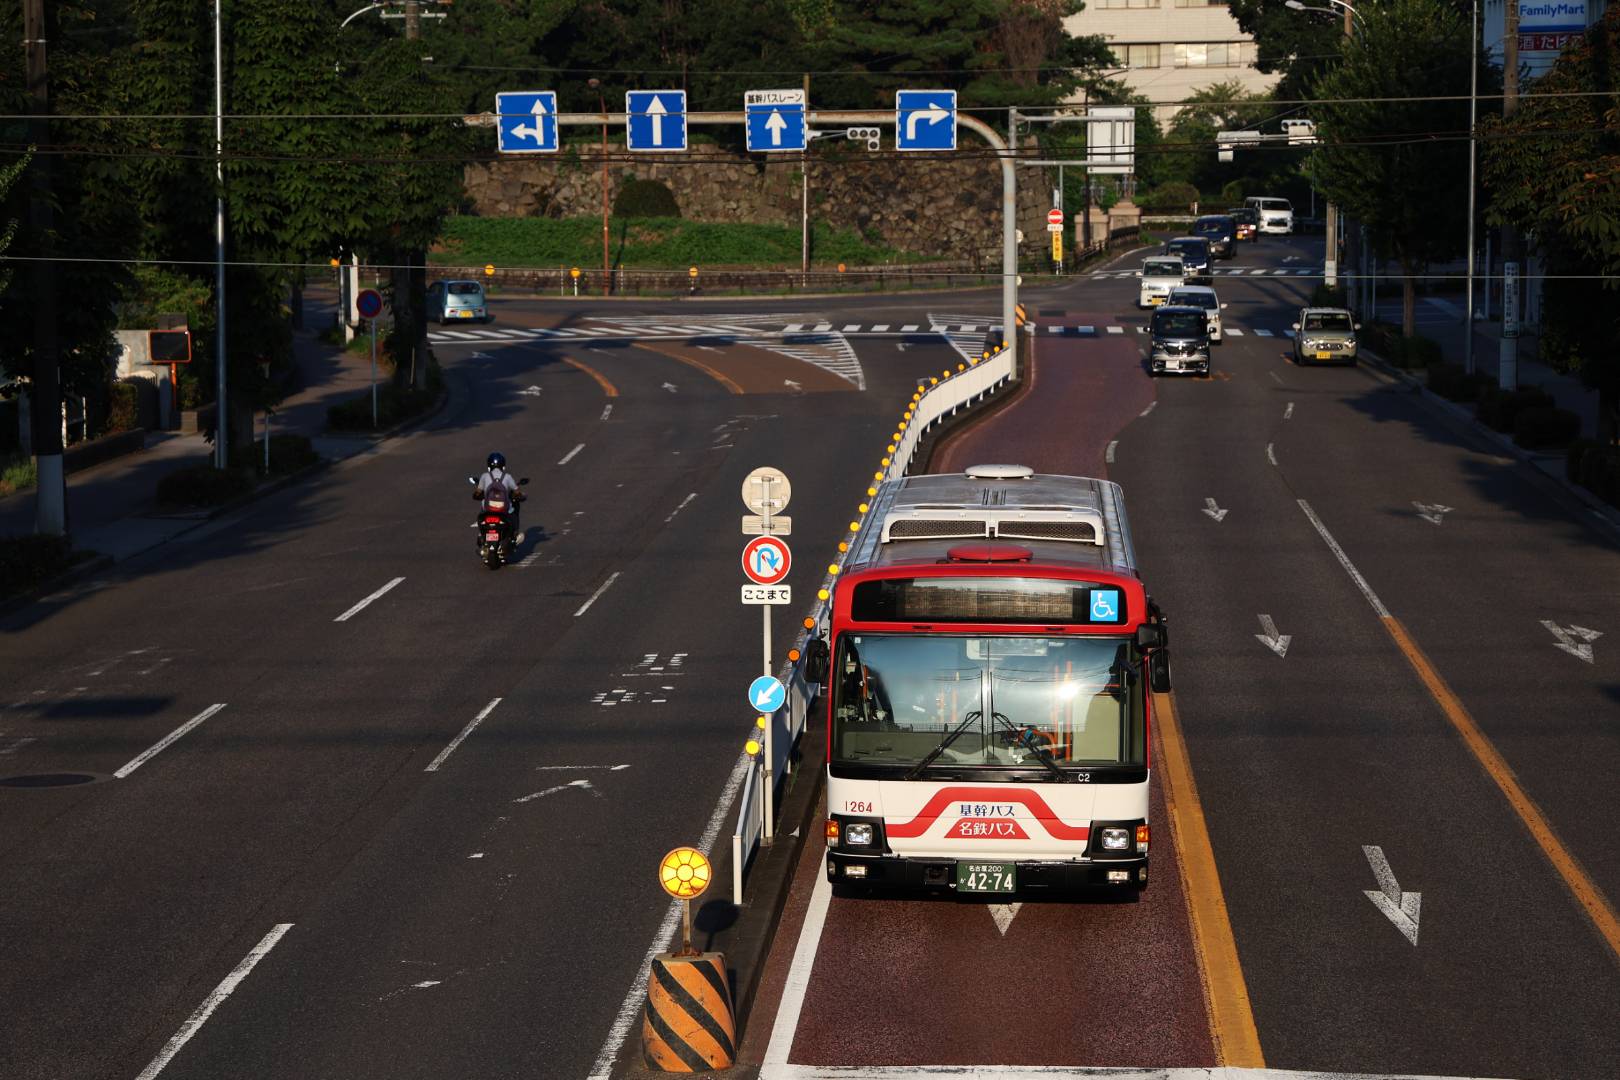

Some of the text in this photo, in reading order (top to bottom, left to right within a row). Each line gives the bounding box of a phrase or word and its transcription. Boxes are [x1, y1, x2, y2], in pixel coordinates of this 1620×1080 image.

[1520, 4, 1584, 17] FamilyMart
[748, 93, 802, 103] 基幹バスレーン
[744, 589, 789, 600] ここまで
[1078, 773, 1090, 782] C2
[845, 800, 873, 813] 1264
[960, 804, 1015, 817] 基幹バス
[959, 821, 1016, 836] 名鉄バス
